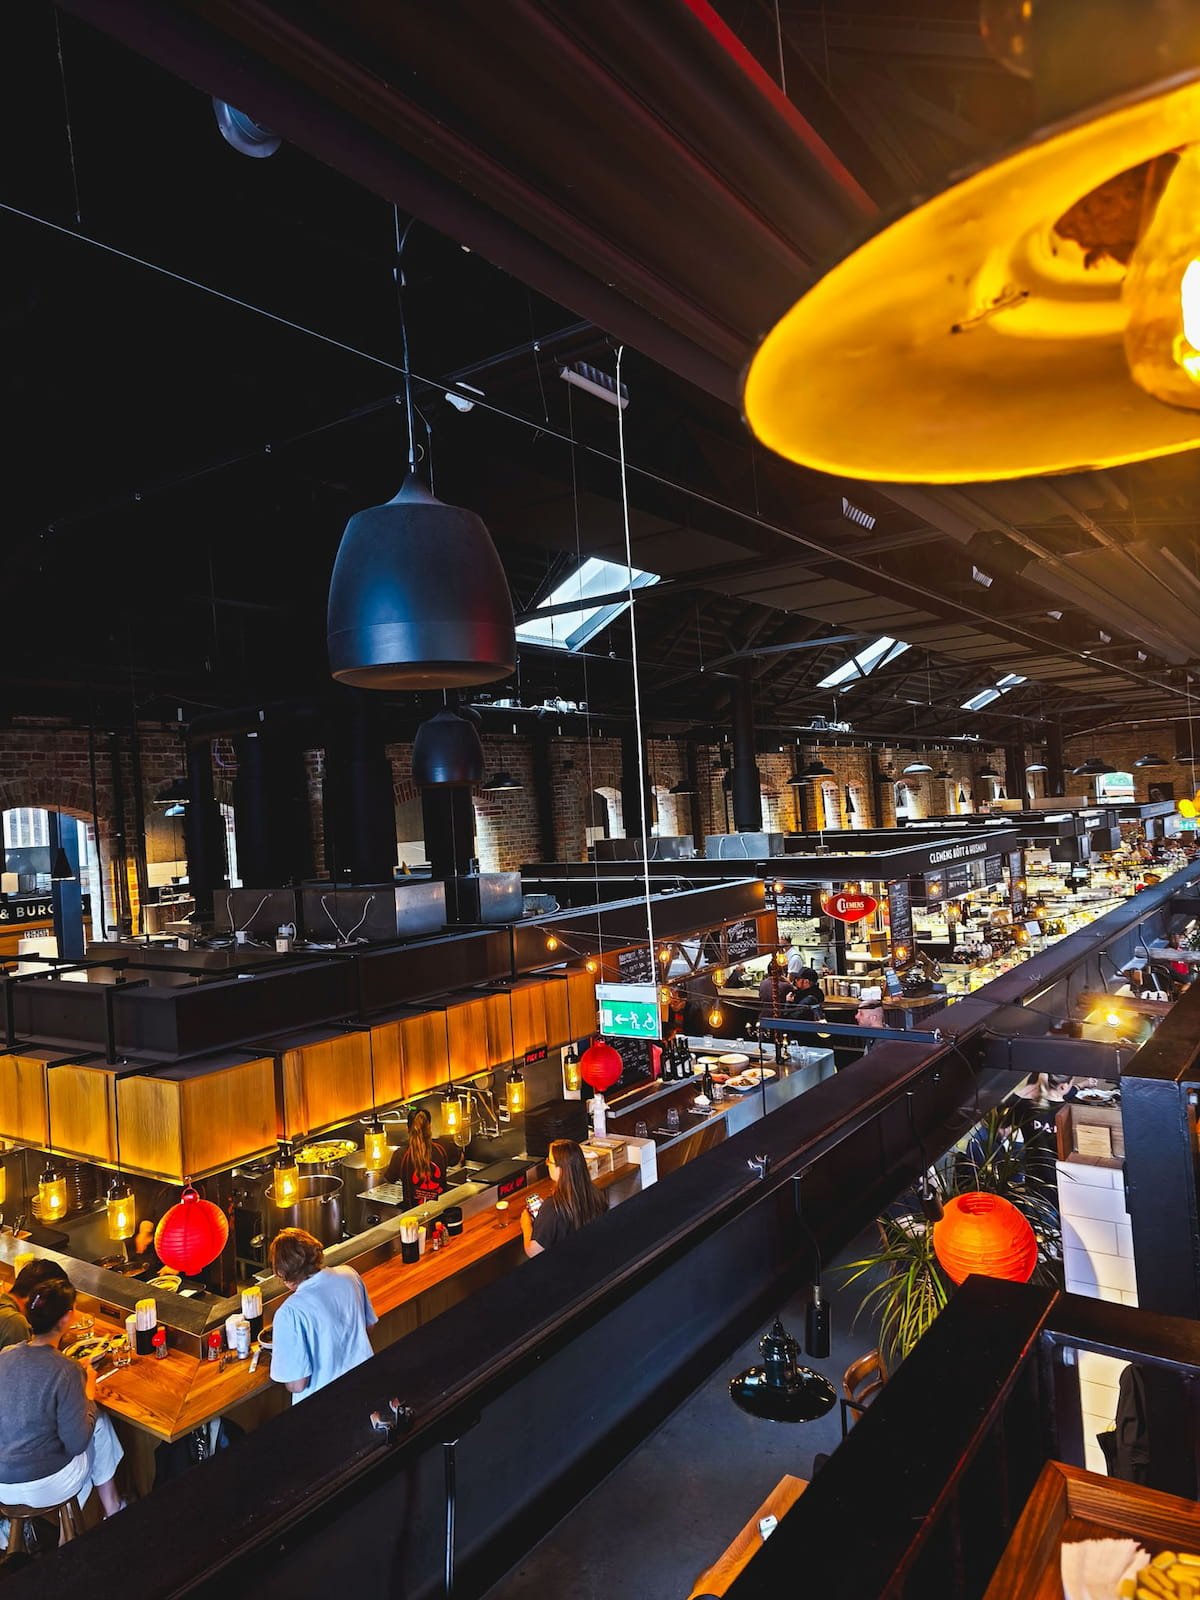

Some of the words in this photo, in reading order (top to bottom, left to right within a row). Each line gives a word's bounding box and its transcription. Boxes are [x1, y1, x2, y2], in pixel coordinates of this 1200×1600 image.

[930, 849, 953, 864] CLEMENS
[0, 908, 9, 919] &
[16, 900, 85, 918] BURGS
